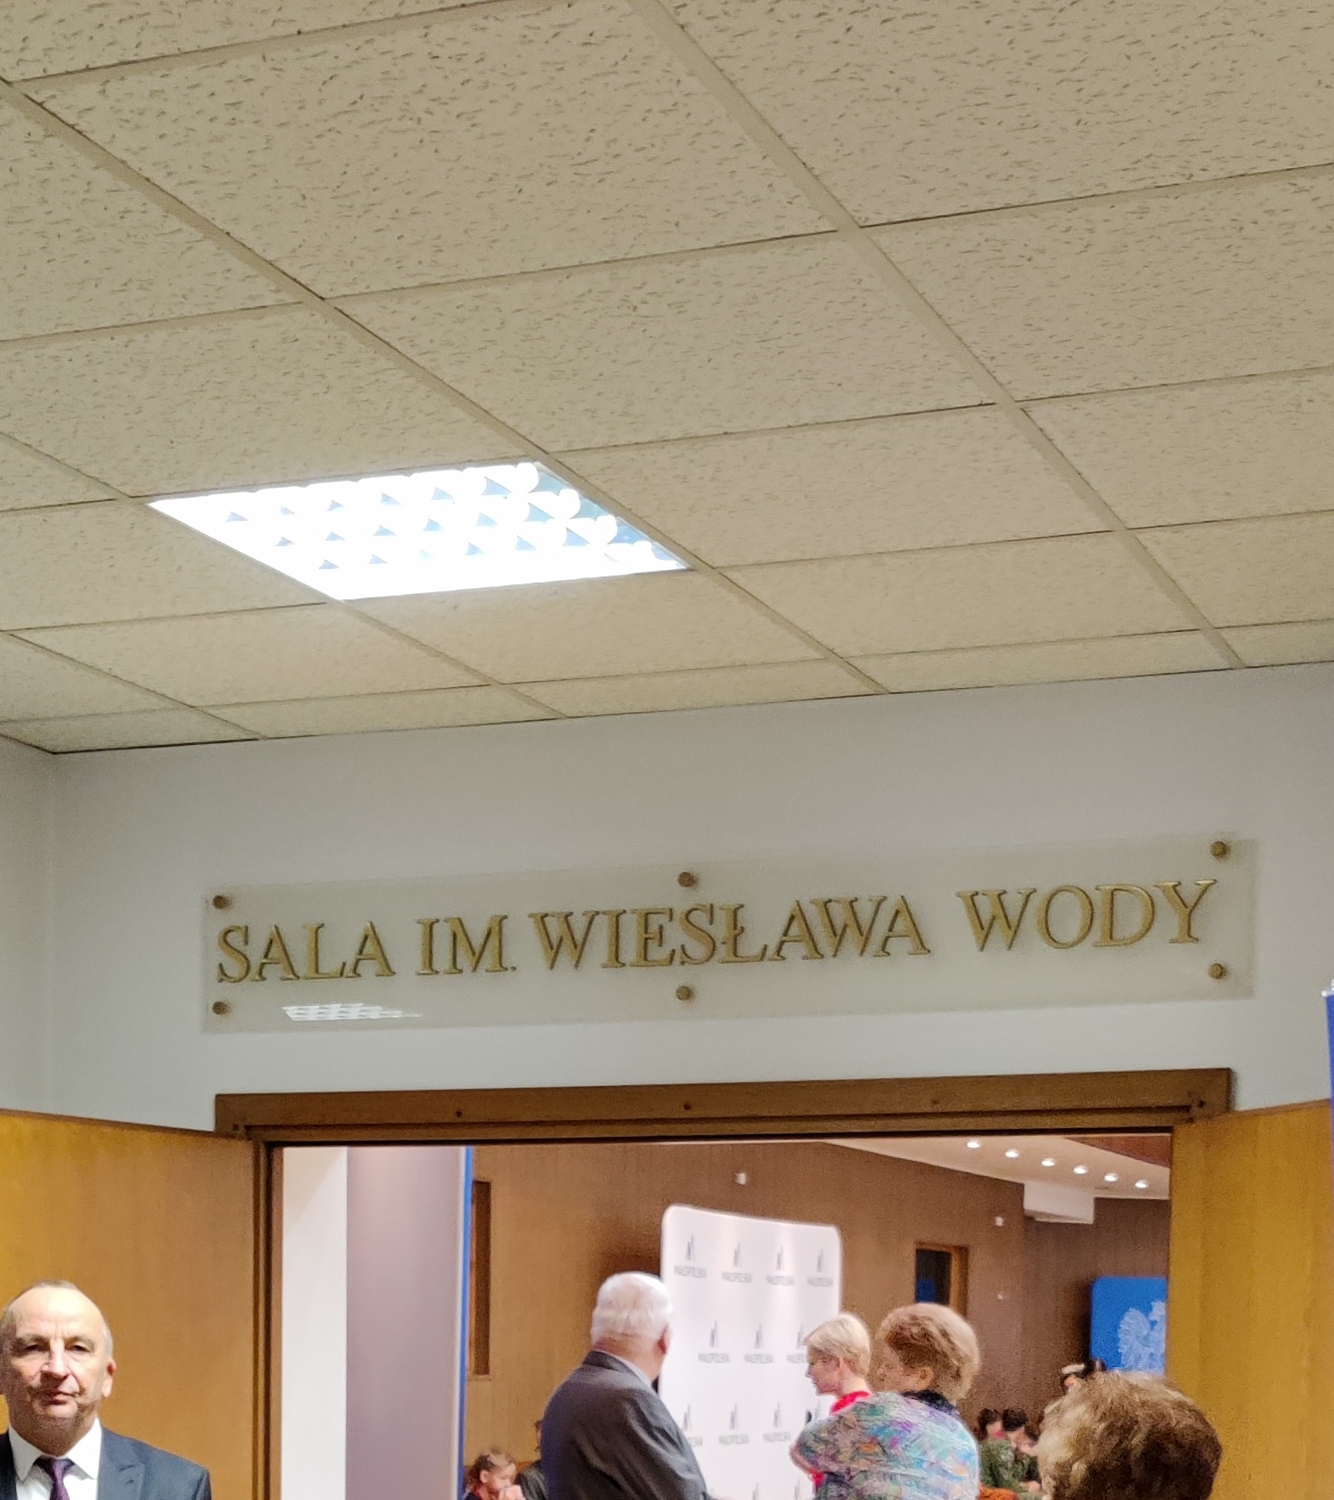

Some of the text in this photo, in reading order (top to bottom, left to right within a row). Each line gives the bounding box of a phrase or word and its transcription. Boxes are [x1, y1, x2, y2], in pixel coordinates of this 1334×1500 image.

[216, 920, 397, 984] SALA
[528, 894, 932, 972] WIESŁAWA
[955, 878, 1219, 953] WODY
